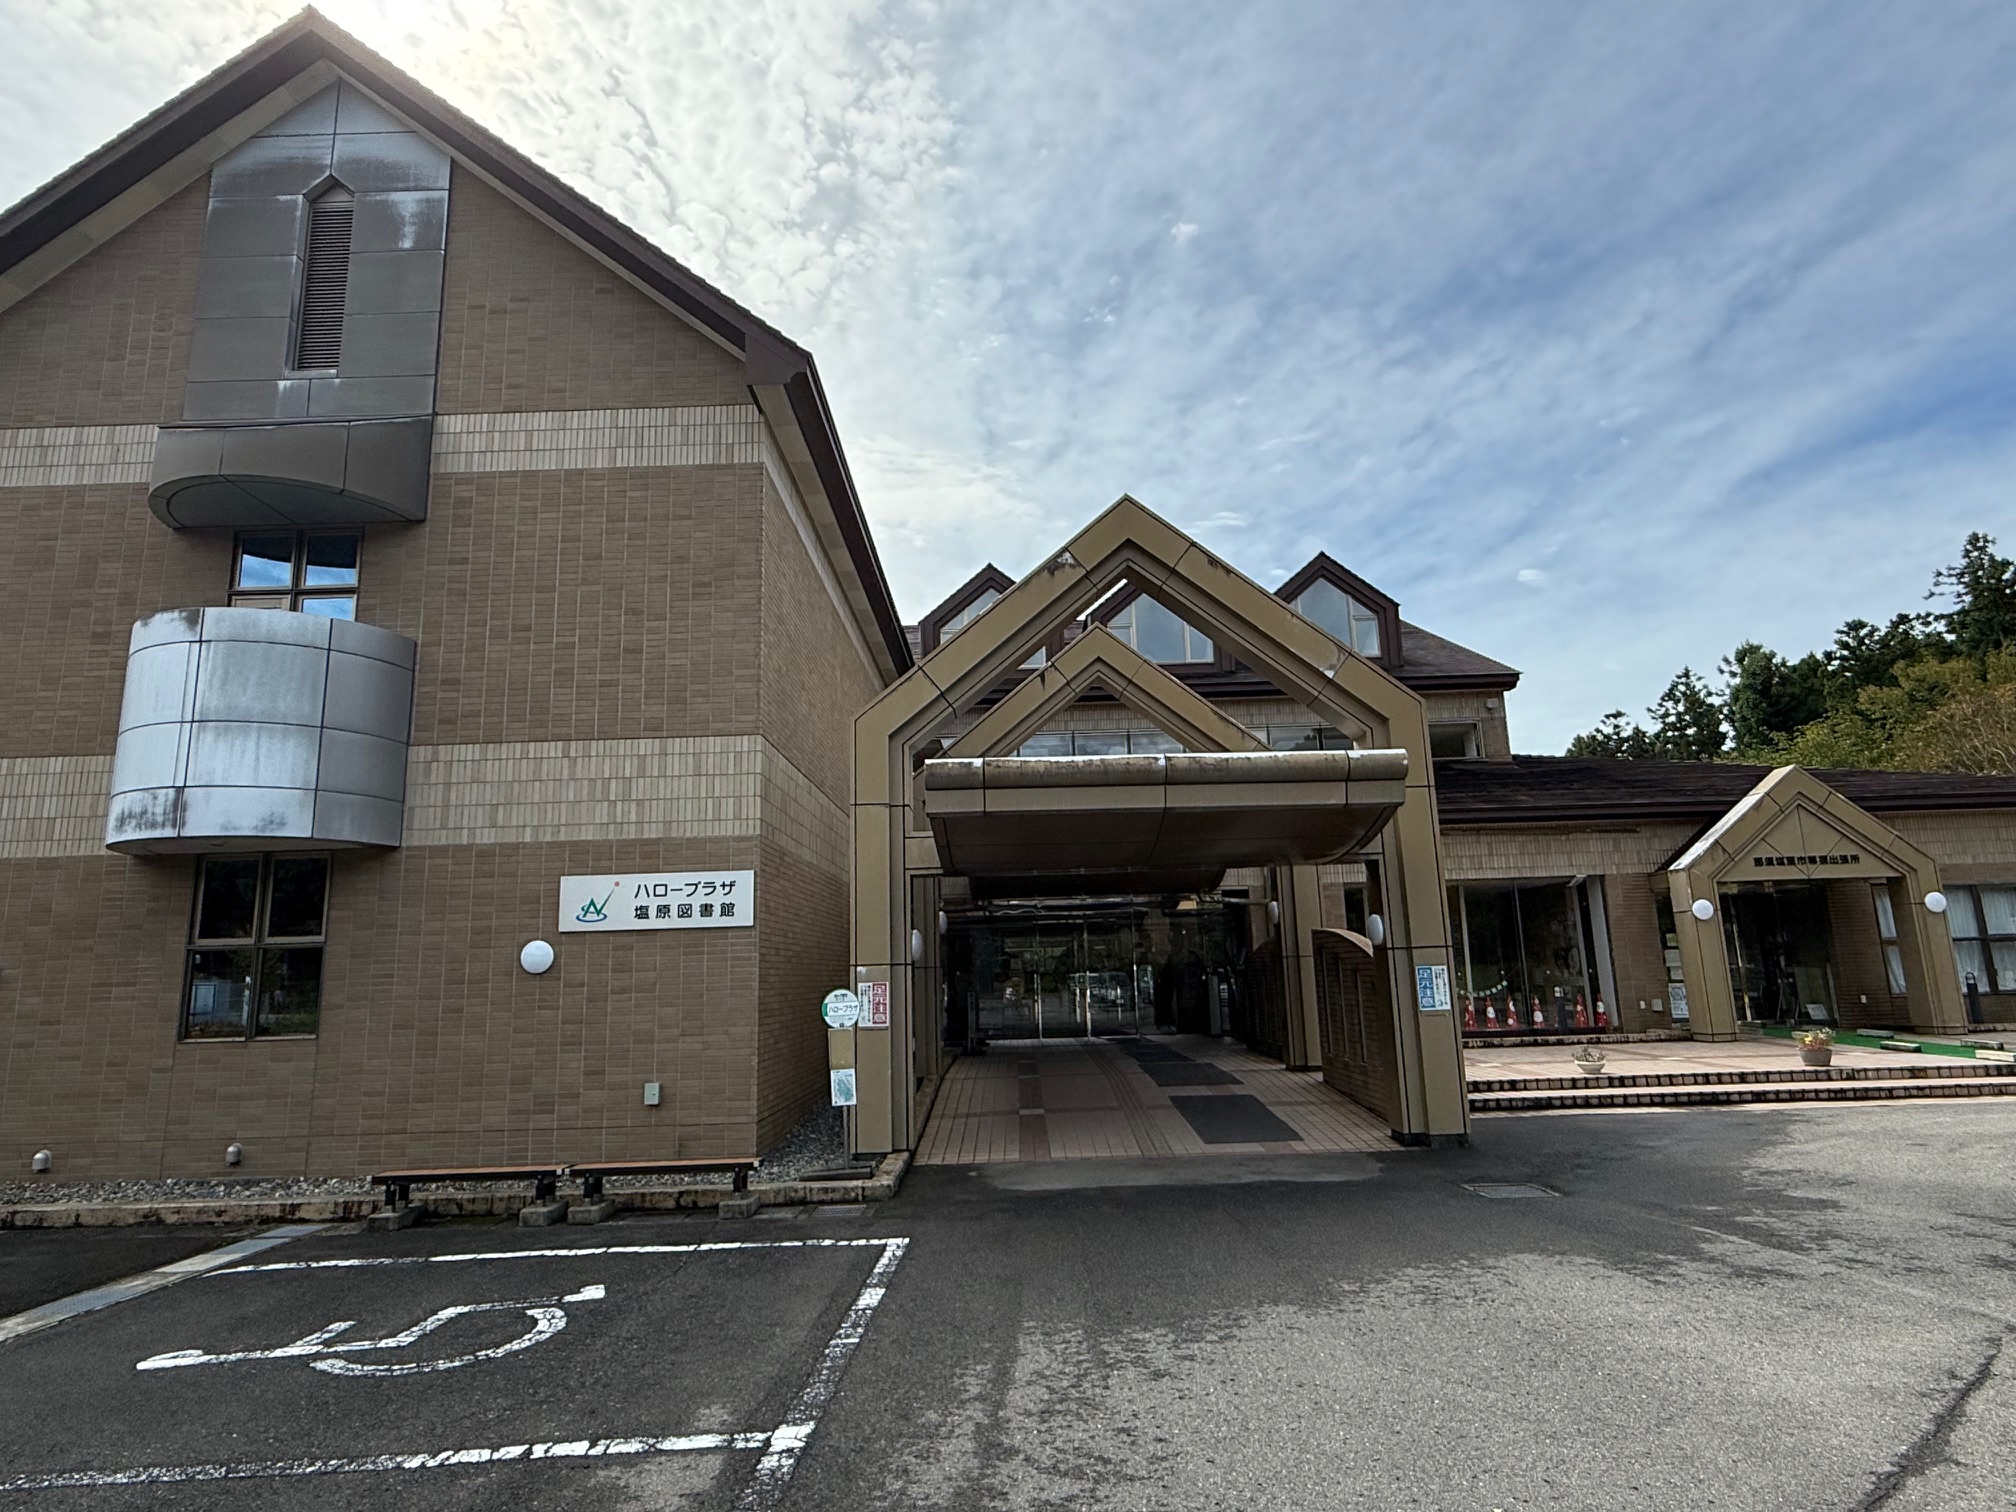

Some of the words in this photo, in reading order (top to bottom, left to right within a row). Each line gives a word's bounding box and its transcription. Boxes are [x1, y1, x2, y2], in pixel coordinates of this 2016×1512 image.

[634, 880, 736, 899] ハロープラザ
[634, 902, 736, 920] 塩原図書館
[1419, 969, 1435, 1007] 足元注意
[828, 1004, 859, 1014] ハロープラザ
[873, 984, 887, 1023] 足元注意
